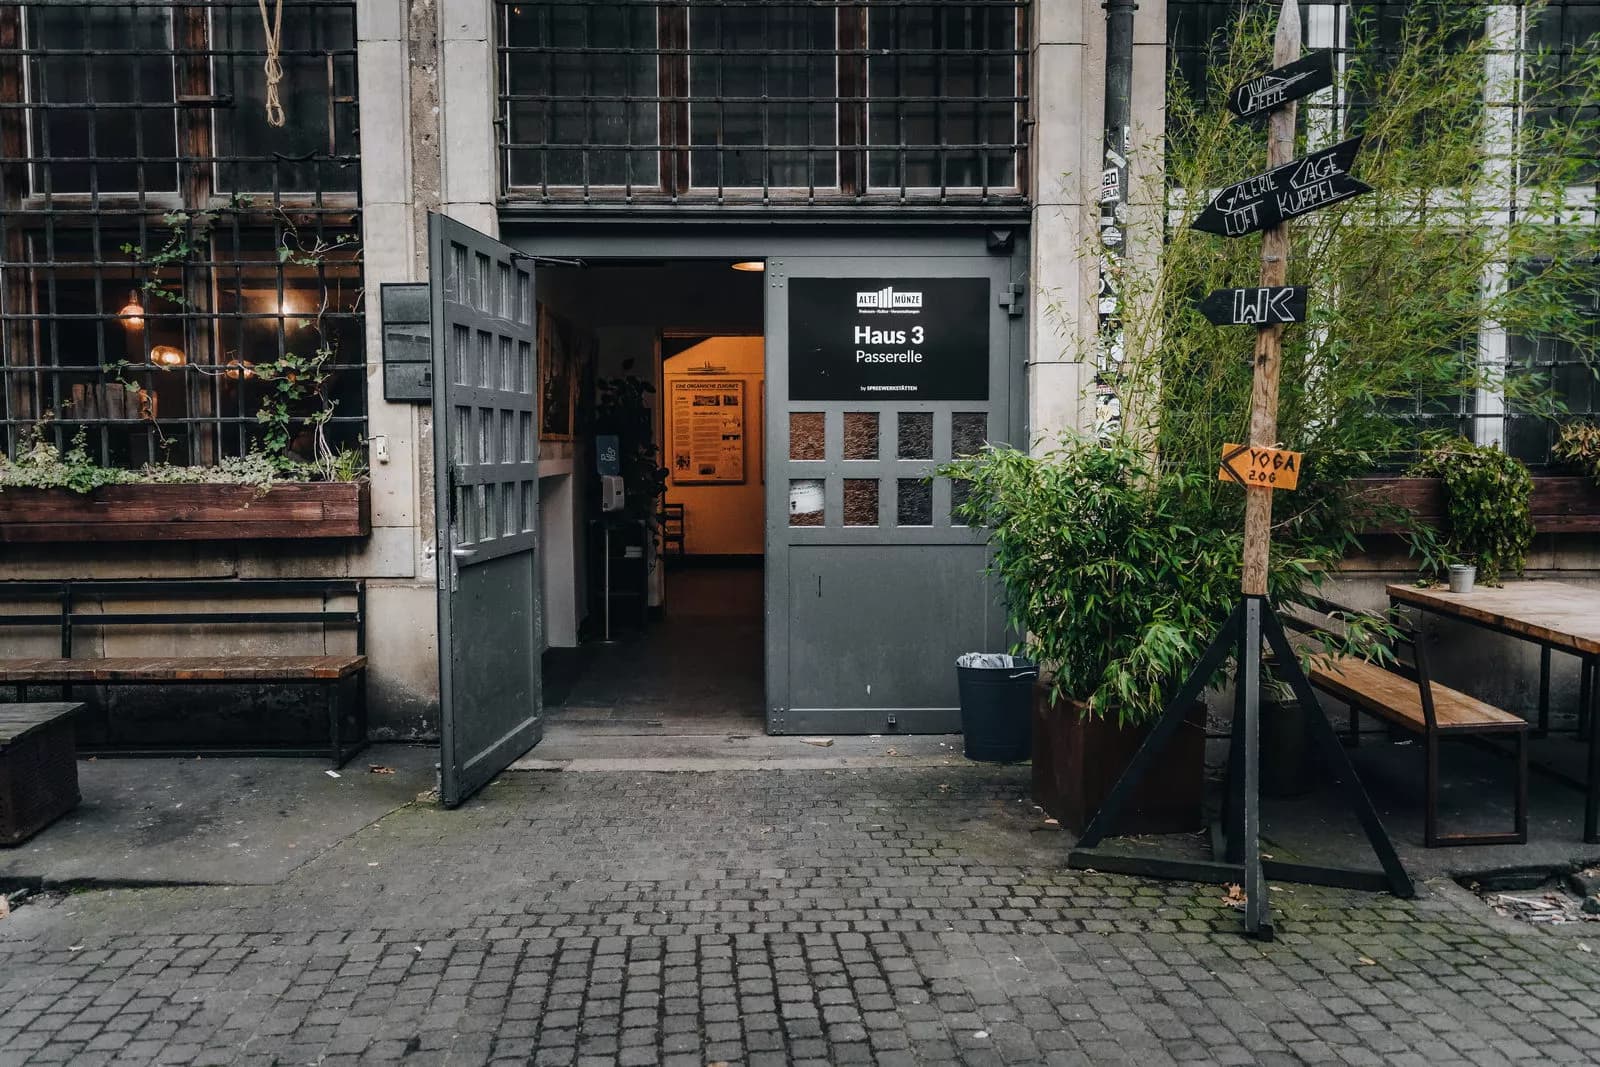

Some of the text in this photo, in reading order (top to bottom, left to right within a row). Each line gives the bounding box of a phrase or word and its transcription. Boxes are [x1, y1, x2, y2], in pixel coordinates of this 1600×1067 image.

[1238, 75, 1287, 114] OLIVIA
[1215, 153, 1340, 212] GALERIE CAGE
[1224, 180, 1345, 236] LOFT KUPPEL
[858, 294, 920, 304] ALTE MÜNZE
[1233, 287, 1296, 324] WK
[854, 325, 924, 345] Haus 3
[856, 350, 923, 363] Passerelle
[1249, 449, 1296, 473] YOGA
